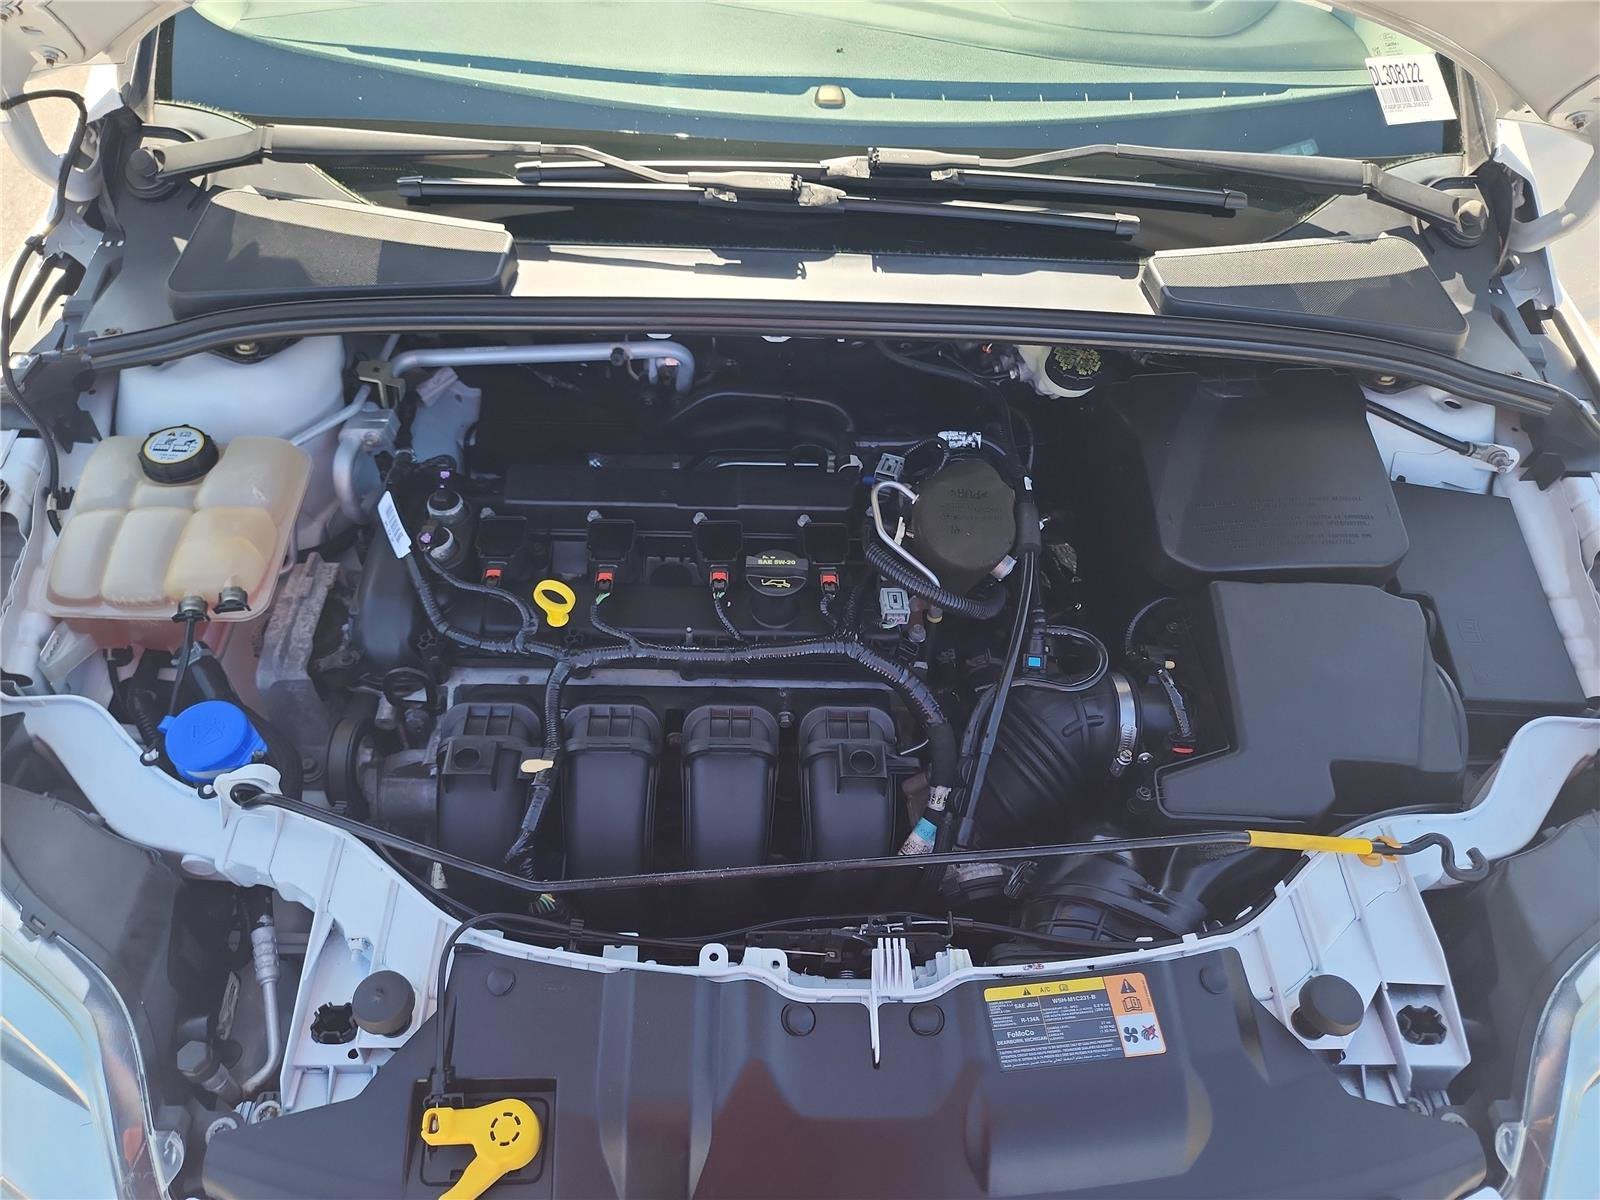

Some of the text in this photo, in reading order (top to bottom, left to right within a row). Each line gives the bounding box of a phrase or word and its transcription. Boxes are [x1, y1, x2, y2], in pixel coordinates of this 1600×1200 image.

[1368, 62, 1424, 86] DL308122
[1006, 1029, 1035, 1038] FoMoCo
[1024, 1035, 1048, 1043] MICHIGAN
